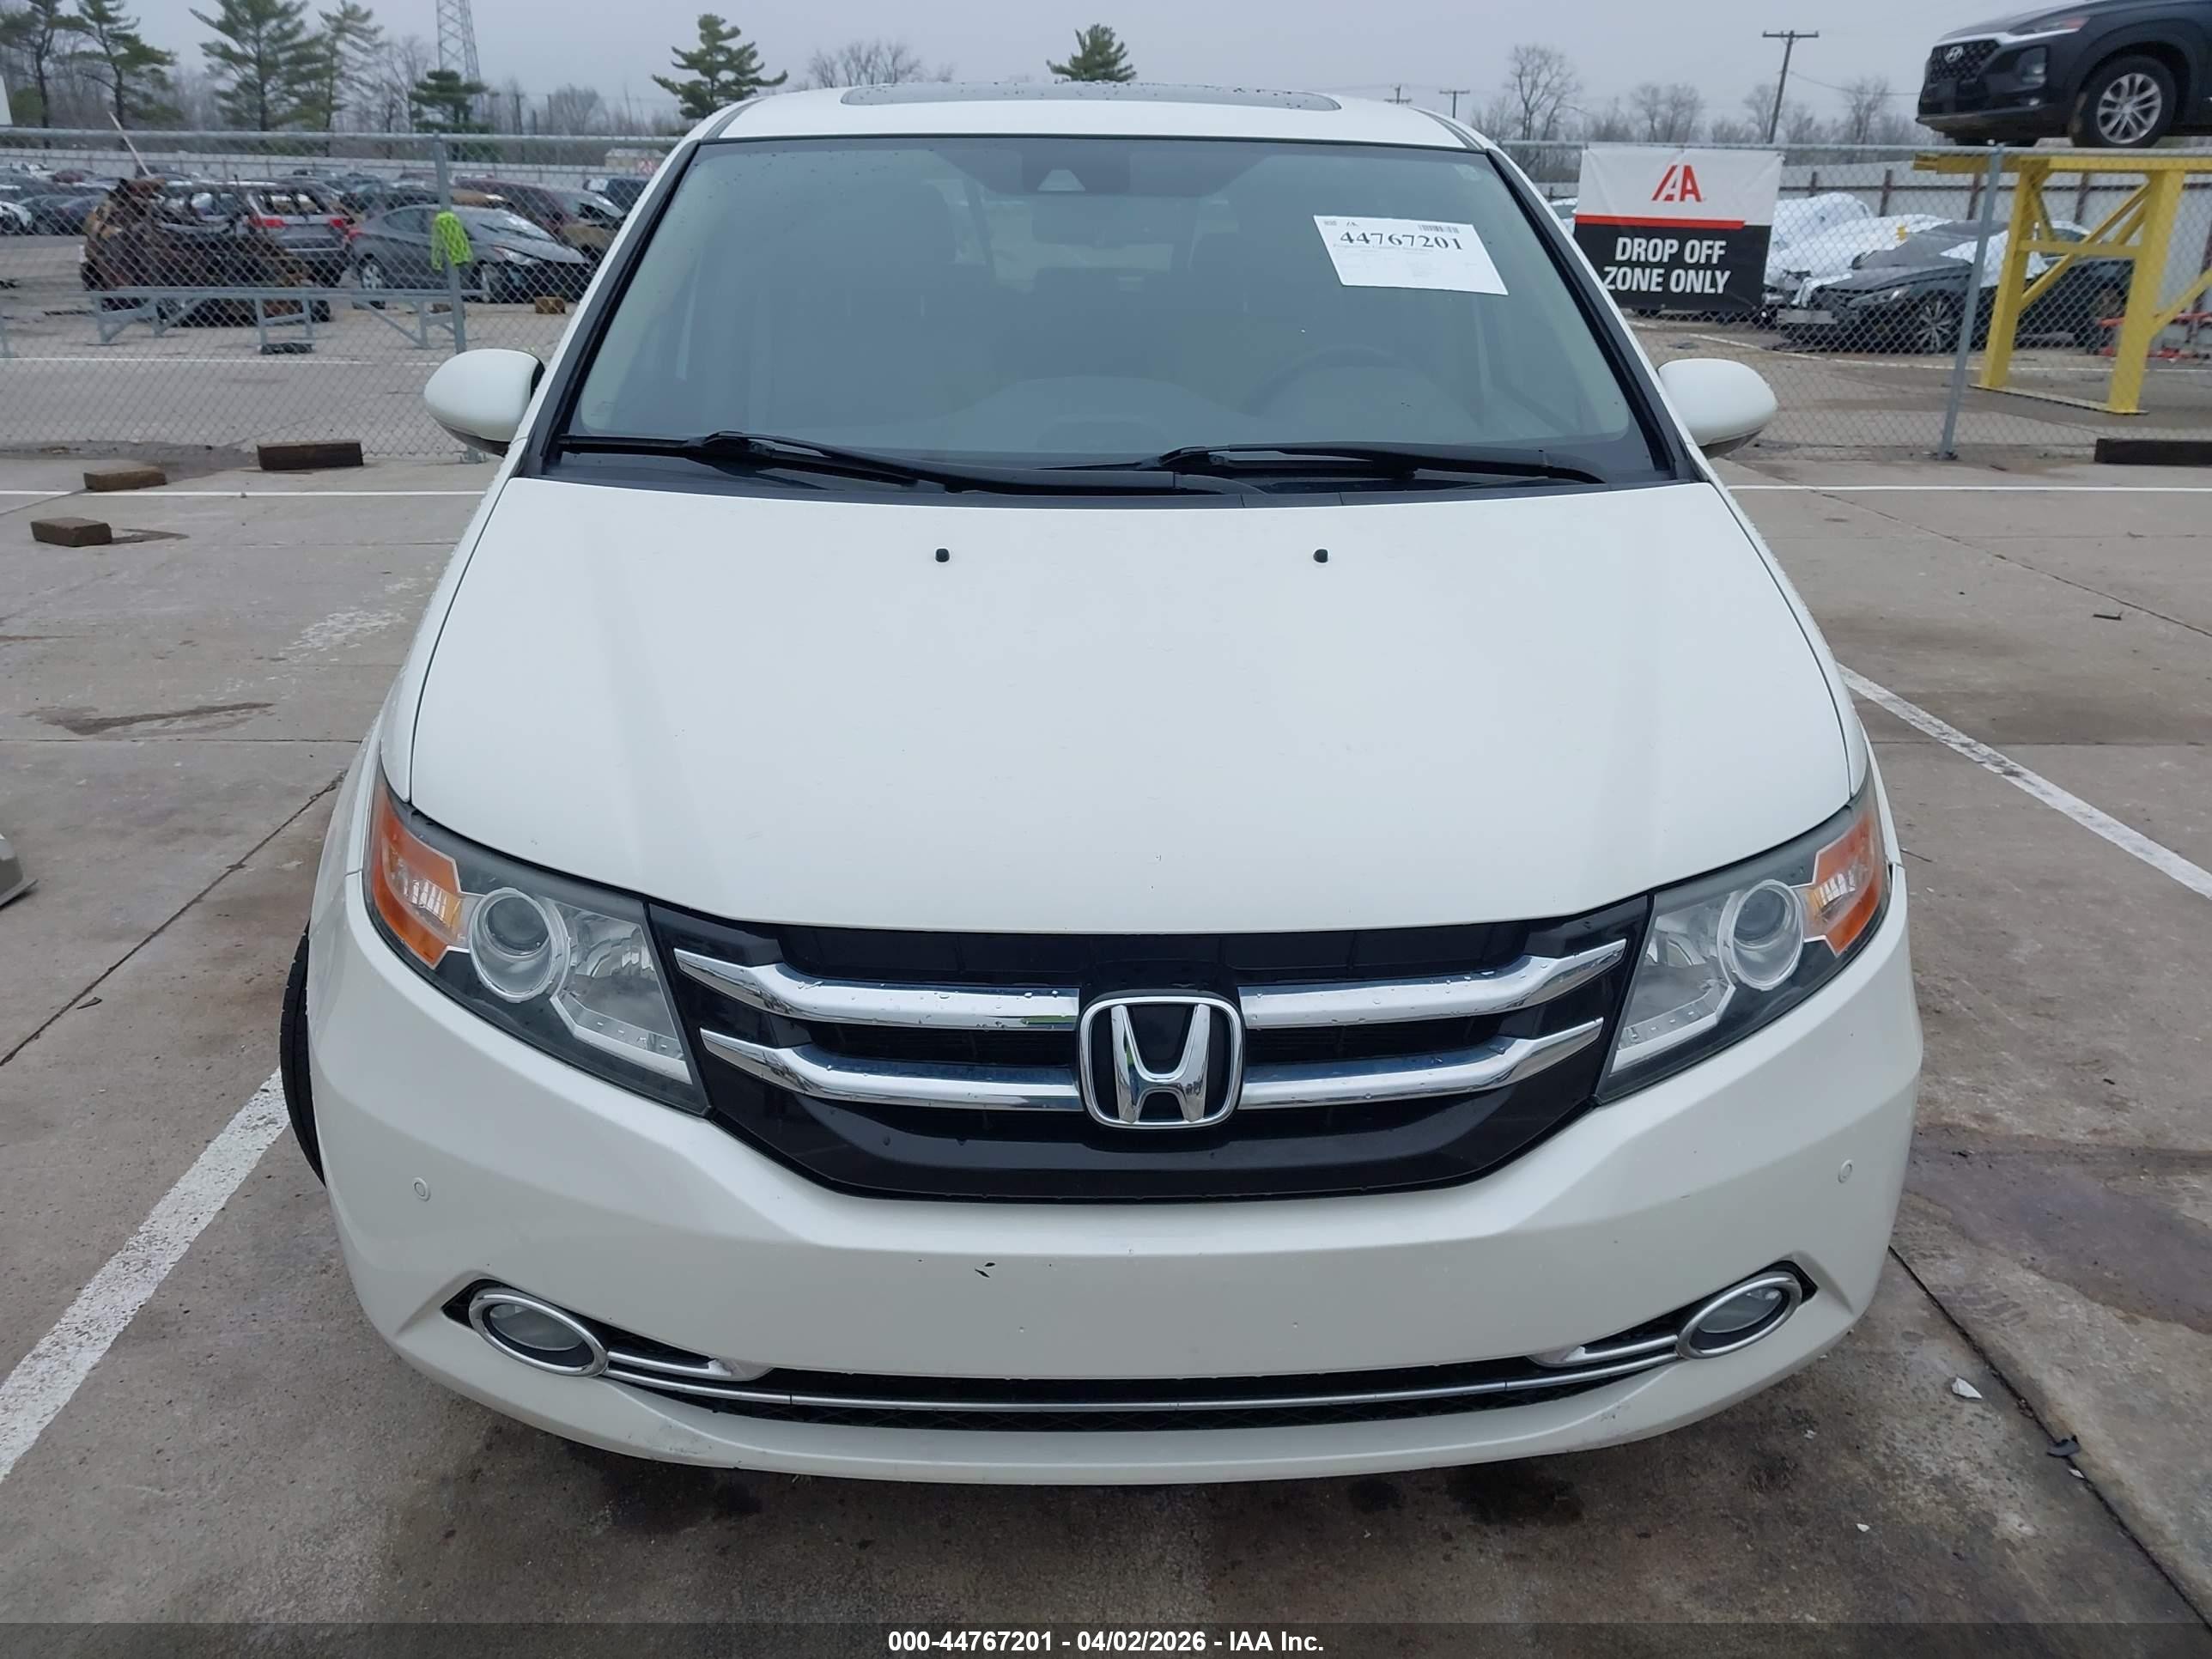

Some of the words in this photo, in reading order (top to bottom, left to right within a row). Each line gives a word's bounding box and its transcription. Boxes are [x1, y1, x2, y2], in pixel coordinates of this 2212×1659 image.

[1340, 231, 1463, 251] 44767201
[1614, 237, 1680, 263] DROP
[1684, 240, 1727, 264] OFF
[1603, 266, 1665, 292] ZONE
[1669, 269, 1731, 295] ONLY
